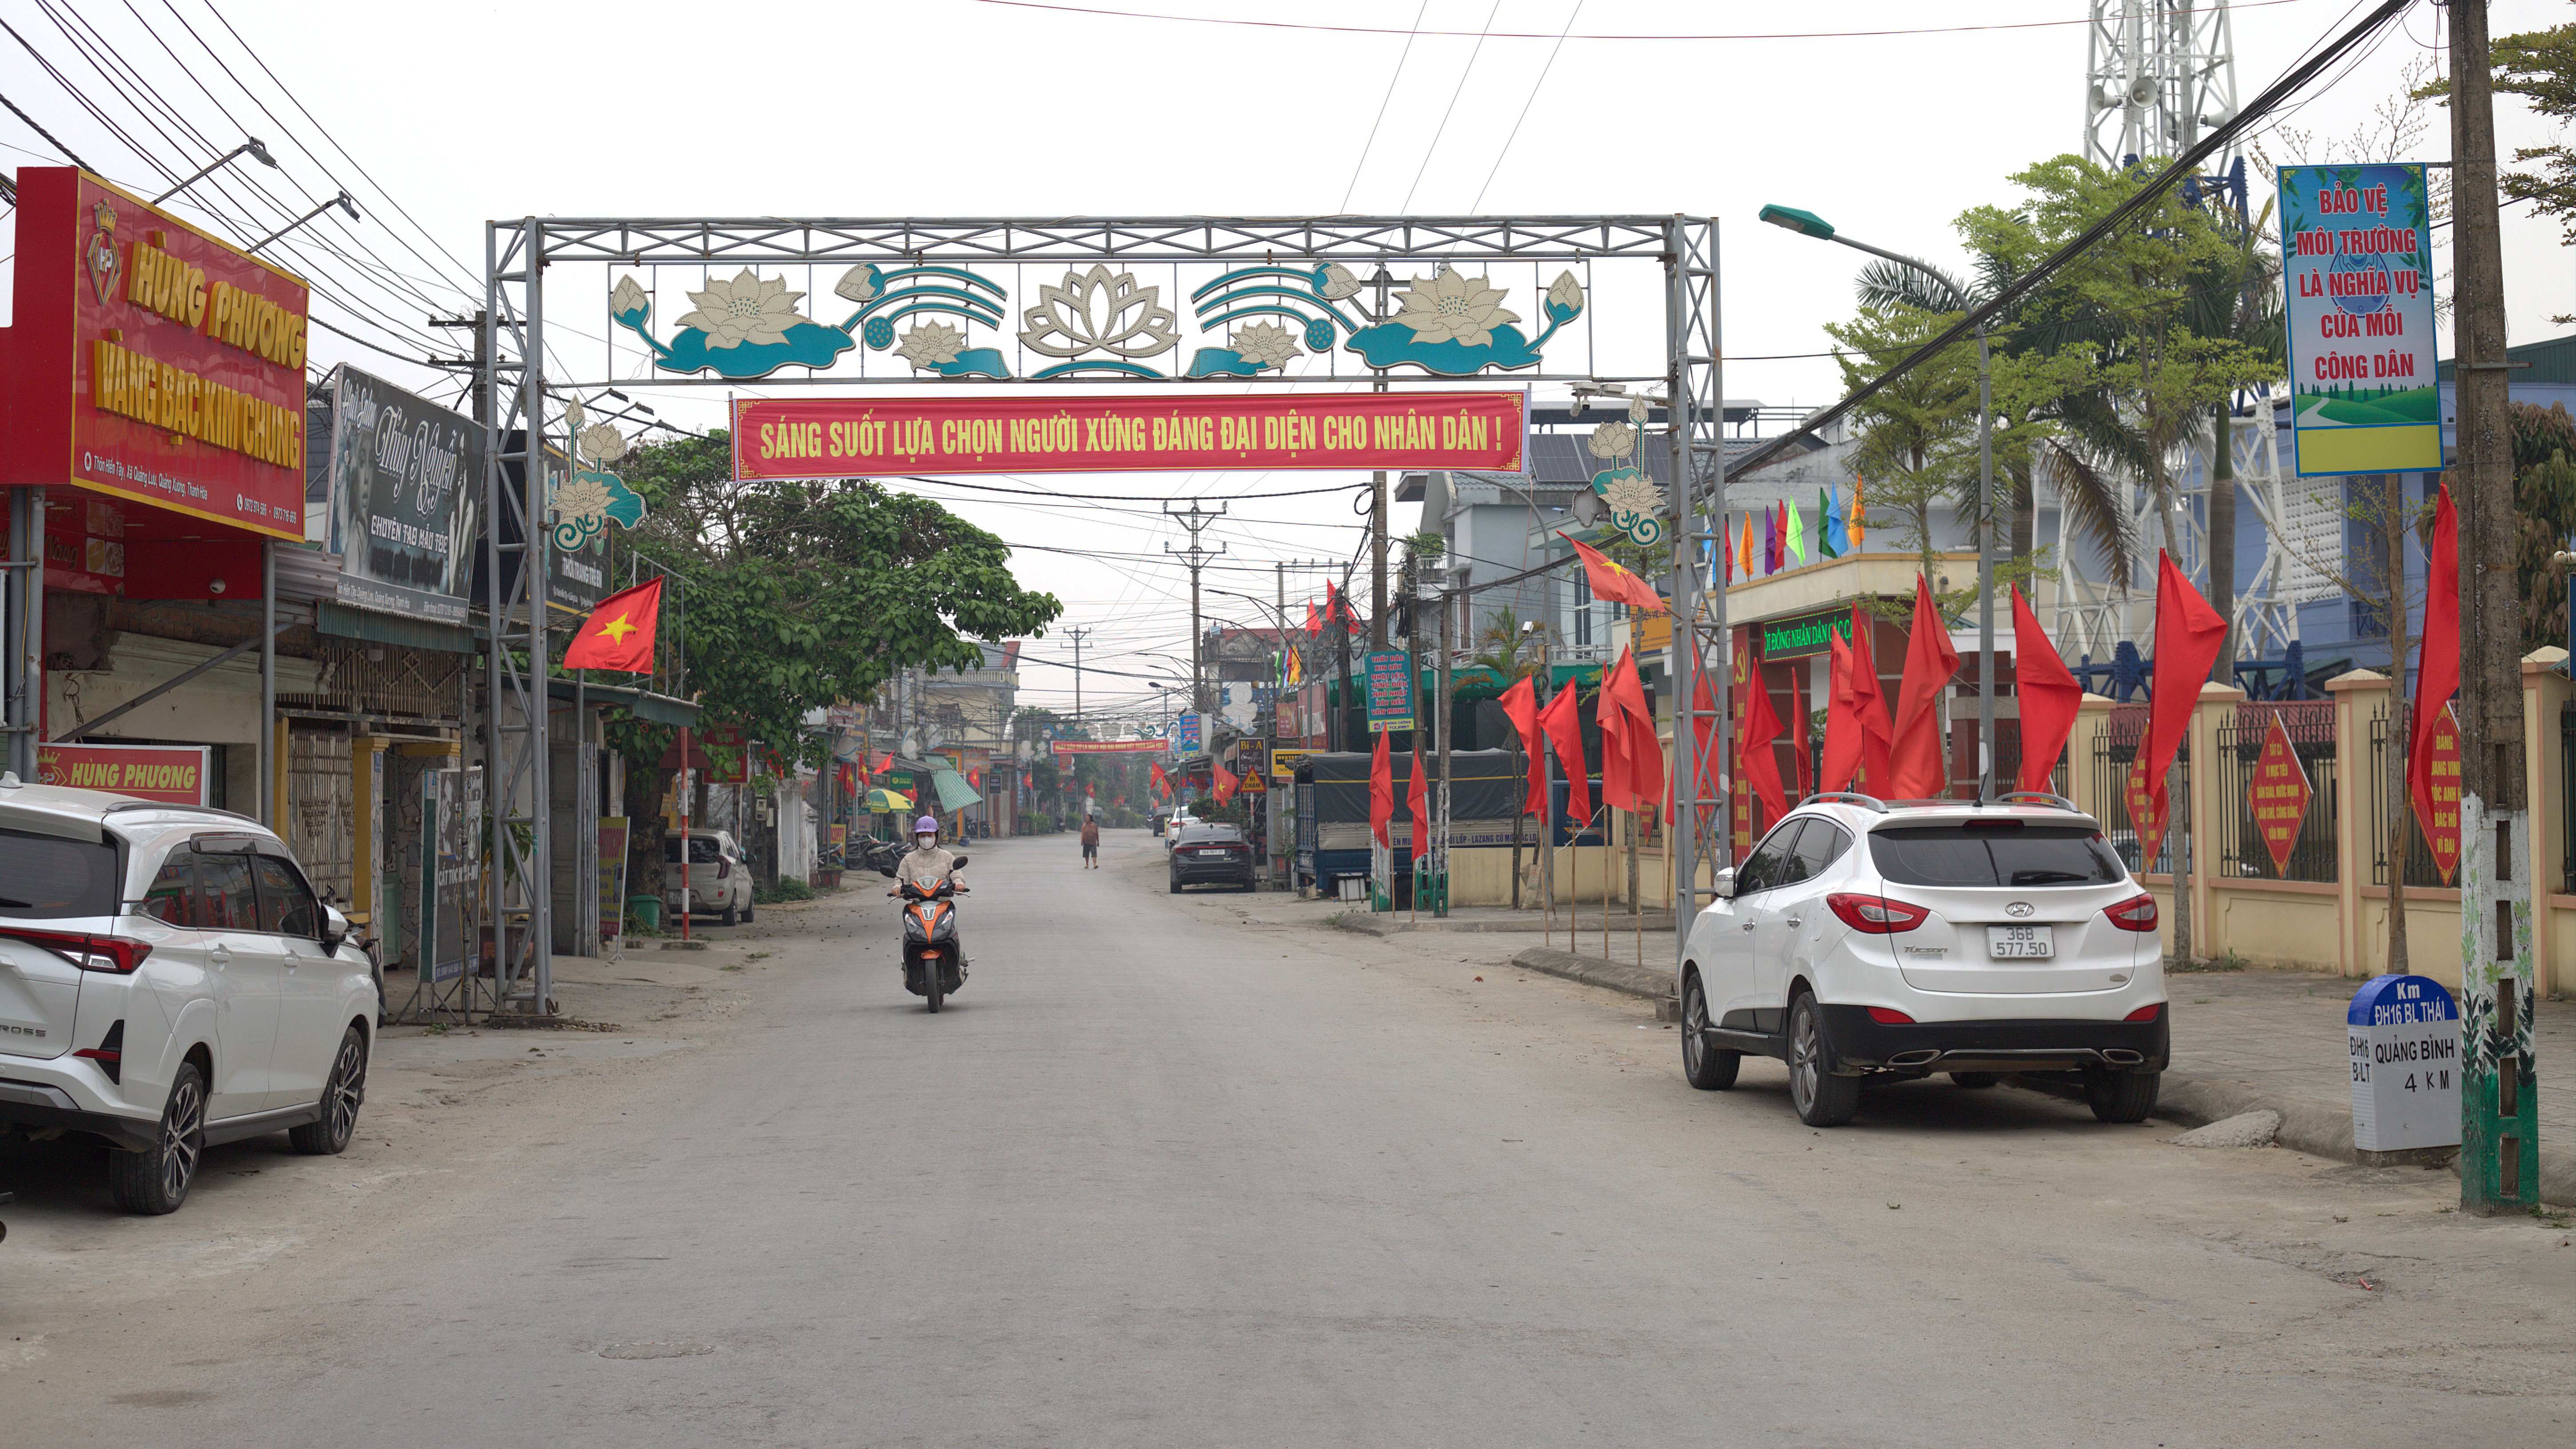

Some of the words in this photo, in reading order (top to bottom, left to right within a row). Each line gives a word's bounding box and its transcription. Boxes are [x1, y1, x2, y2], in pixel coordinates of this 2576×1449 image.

[2319, 180, 2359, 215] BẢO
[2364, 183, 2388, 218] VỆ
[2296, 226, 2335, 257] MÔI
[2339, 223, 2417, 256] TRƯỜNG
[2299, 268, 2324, 299] LÀ
[2329, 266, 2389, 296] NGHĨA
[2393, 270, 2420, 300] VỤ
[127, 230, 208, 328] HÙNG
[207, 281, 306, 370] PHƯƠNG
[2321, 307, 2360, 338] CỦA
[2366, 304, 2403, 337] MỖI
[2315, 351, 2368, 380] CÔNG
[2374, 349, 2414, 378] DÂN
[94, 328, 156, 424] VÀNG
[156, 362, 200, 445] BẠC
[199, 378, 240, 450] KIM
[239, 393, 300, 470] CHUNG
[760, 415, 822, 460] SÁNG
[829, 408, 886, 457] SUỐT
[893, 416, 935, 463] LỰA
[942, 419, 1002, 462] CHỌN
[1010, 409, 1078, 453] NGƯỜI
[1085, 410, 1146, 451] XỨNG
[1153, 409, 1214, 451] ĐÁNG
[1220, 416, 1257, 458] ĐẠI
[1265, 408, 1316, 458] DIỆN
[1323, 415, 1368, 450] CHO
[1375, 408, 1435, 450] NHÂN
[1444, 408, 1488, 451] DÂN
[1496, 416, 1502, 451] !
[94, 455, 105, 472] Thôn
[126, 464, 132, 480] Xã
[134, 465, 147, 488] Quảng
[159, 473, 171, 493] Quảng
[187, 482, 199, 498] Thanh
[371, 514, 402, 542] CHUYÊN
[403, 524, 417, 550] TẠO
[418, 523, 434, 550] MẪU
[435, 530, 448, 554] TÓC
[574, 561, 589, 584] TRANG
[596, 569, 602, 588] EM
[1791, 622, 1811, 648] NHÂN
[1812, 620, 1827, 644] DÂN
[1371, 654, 1388, 662] THẤY
[1372, 689, 1388, 697] NHỎ
[1240, 741, 1249, 750] Bi
[1256, 741, 1262, 750] A
[2436, 730, 2453, 750] ĐẢNG
[70, 758, 119, 787] HÙNG
[124, 764, 196, 789] PHƯƠNG
[2443, 787, 2456, 802] ANH
[2435, 809, 2447, 828] BÁC
[2448, 808, 2456, 828] HỒ
[1472, 834, 1493, 843] LAZANG
[2437, 836, 2444, 853] VĨ
[2444, 838, 2455, 857] ĐẠI
[2006, 928, 2034, 941] 36B
[1996, 942, 2047, 956] 577.50
[2397, 983, 2420, 1000] Km
[2375, 1005, 2402, 1026] ĐH16
[2404, 1003, 2419, 1024] BL
[2420, 997, 2445, 1021] THÁI
[2350, 1036, 2369, 1059] ĐH16
[2376, 1035, 2417, 1064] QUẢNG
[2421, 1035, 2454, 1060] BÌNH
[2404, 1073, 2417, 1093] 4
